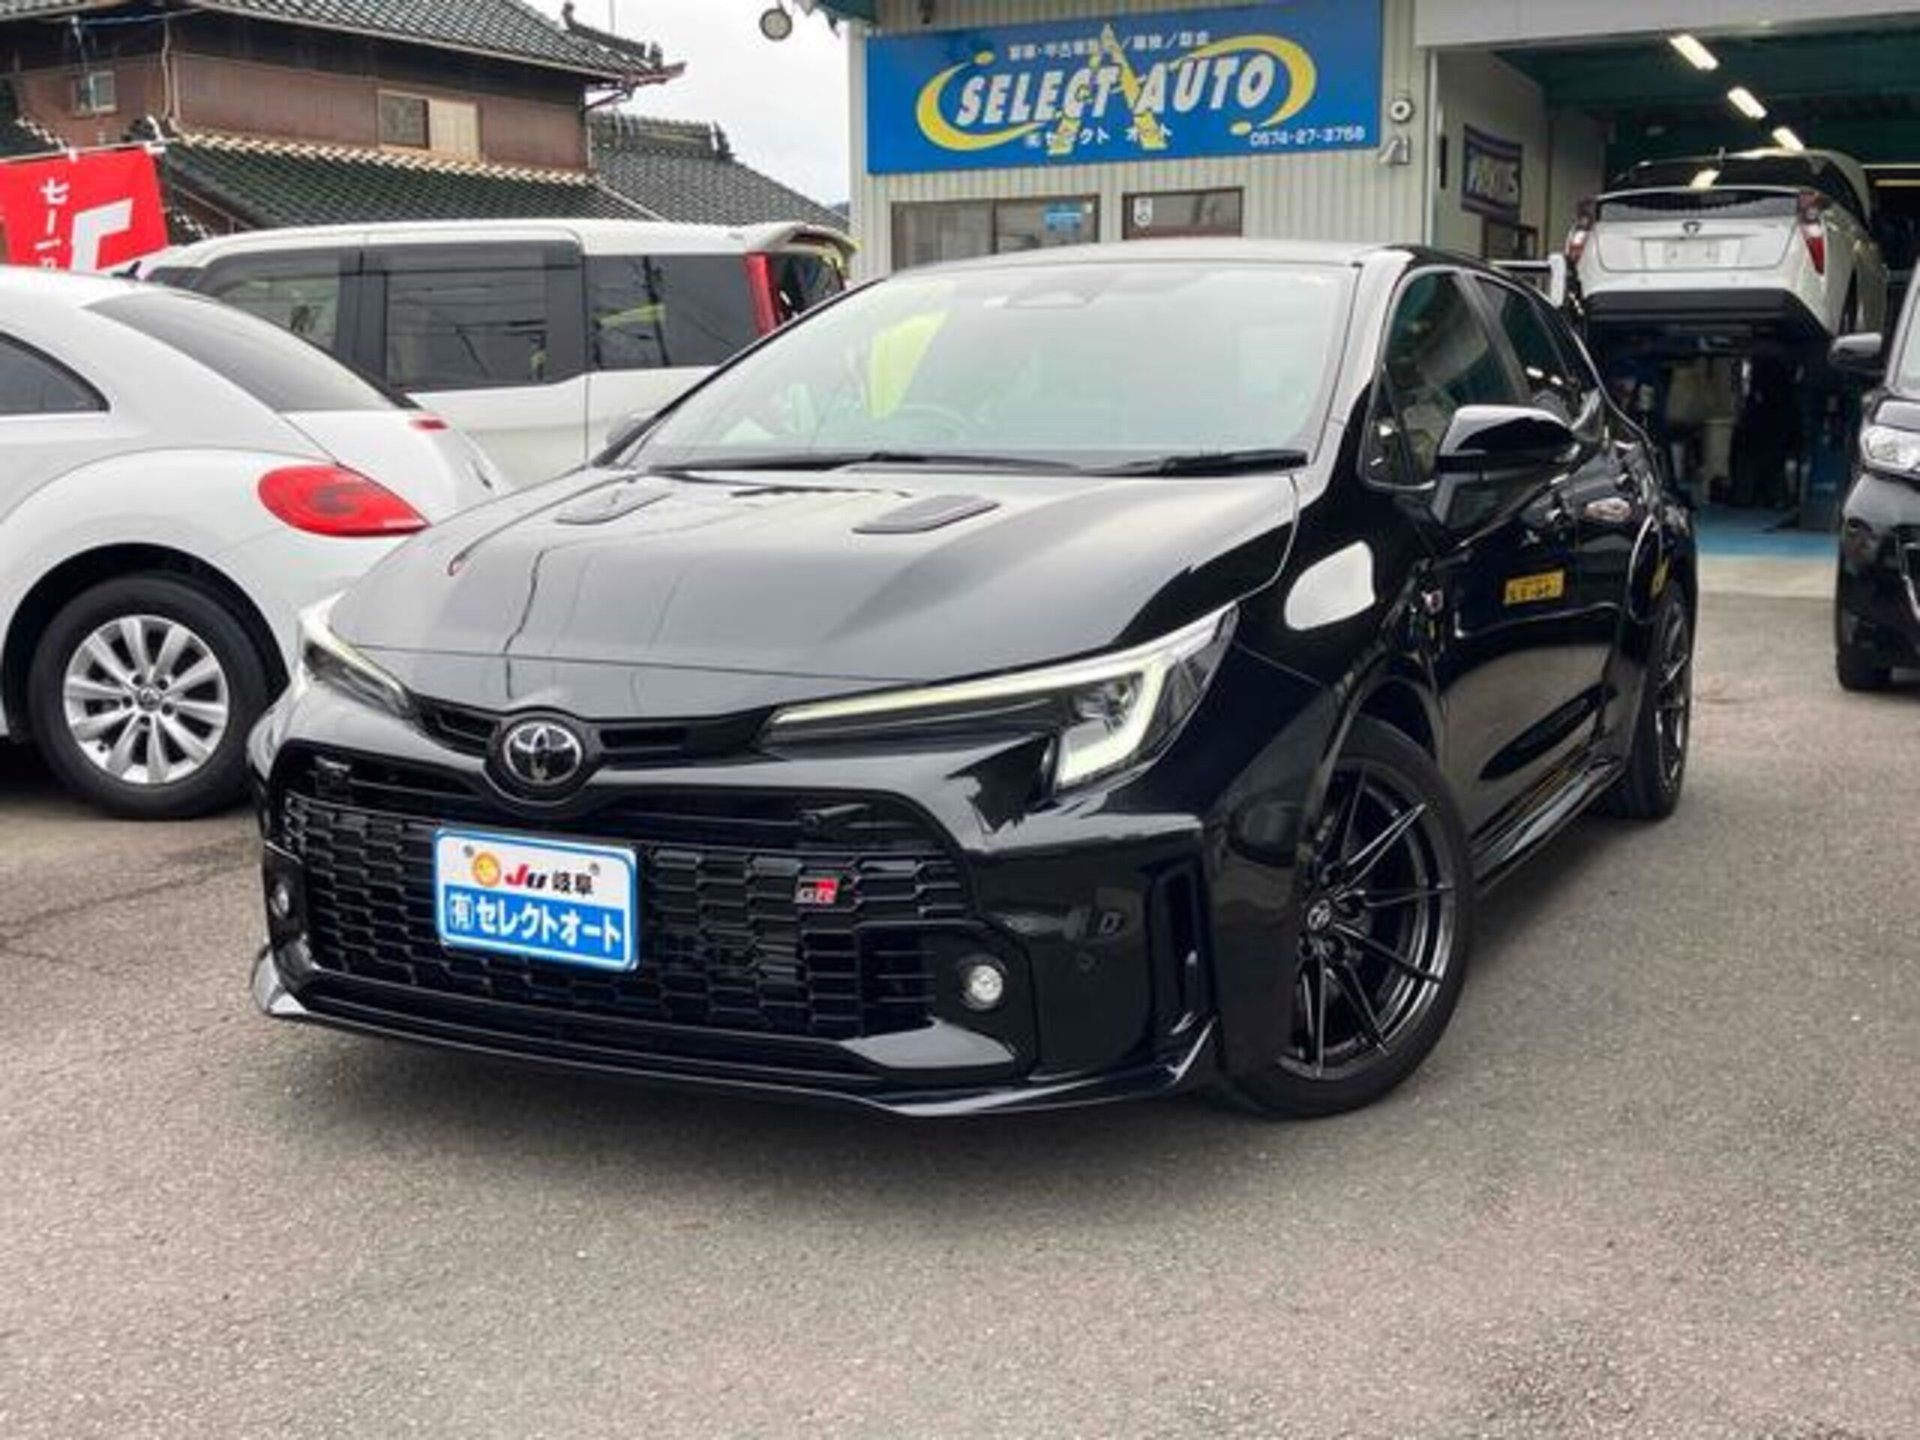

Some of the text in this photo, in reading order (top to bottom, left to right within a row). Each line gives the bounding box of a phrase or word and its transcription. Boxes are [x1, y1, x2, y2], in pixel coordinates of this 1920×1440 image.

[956, 53, 1276, 126] SELECT AUTO
[794, 876, 838, 904] GR
